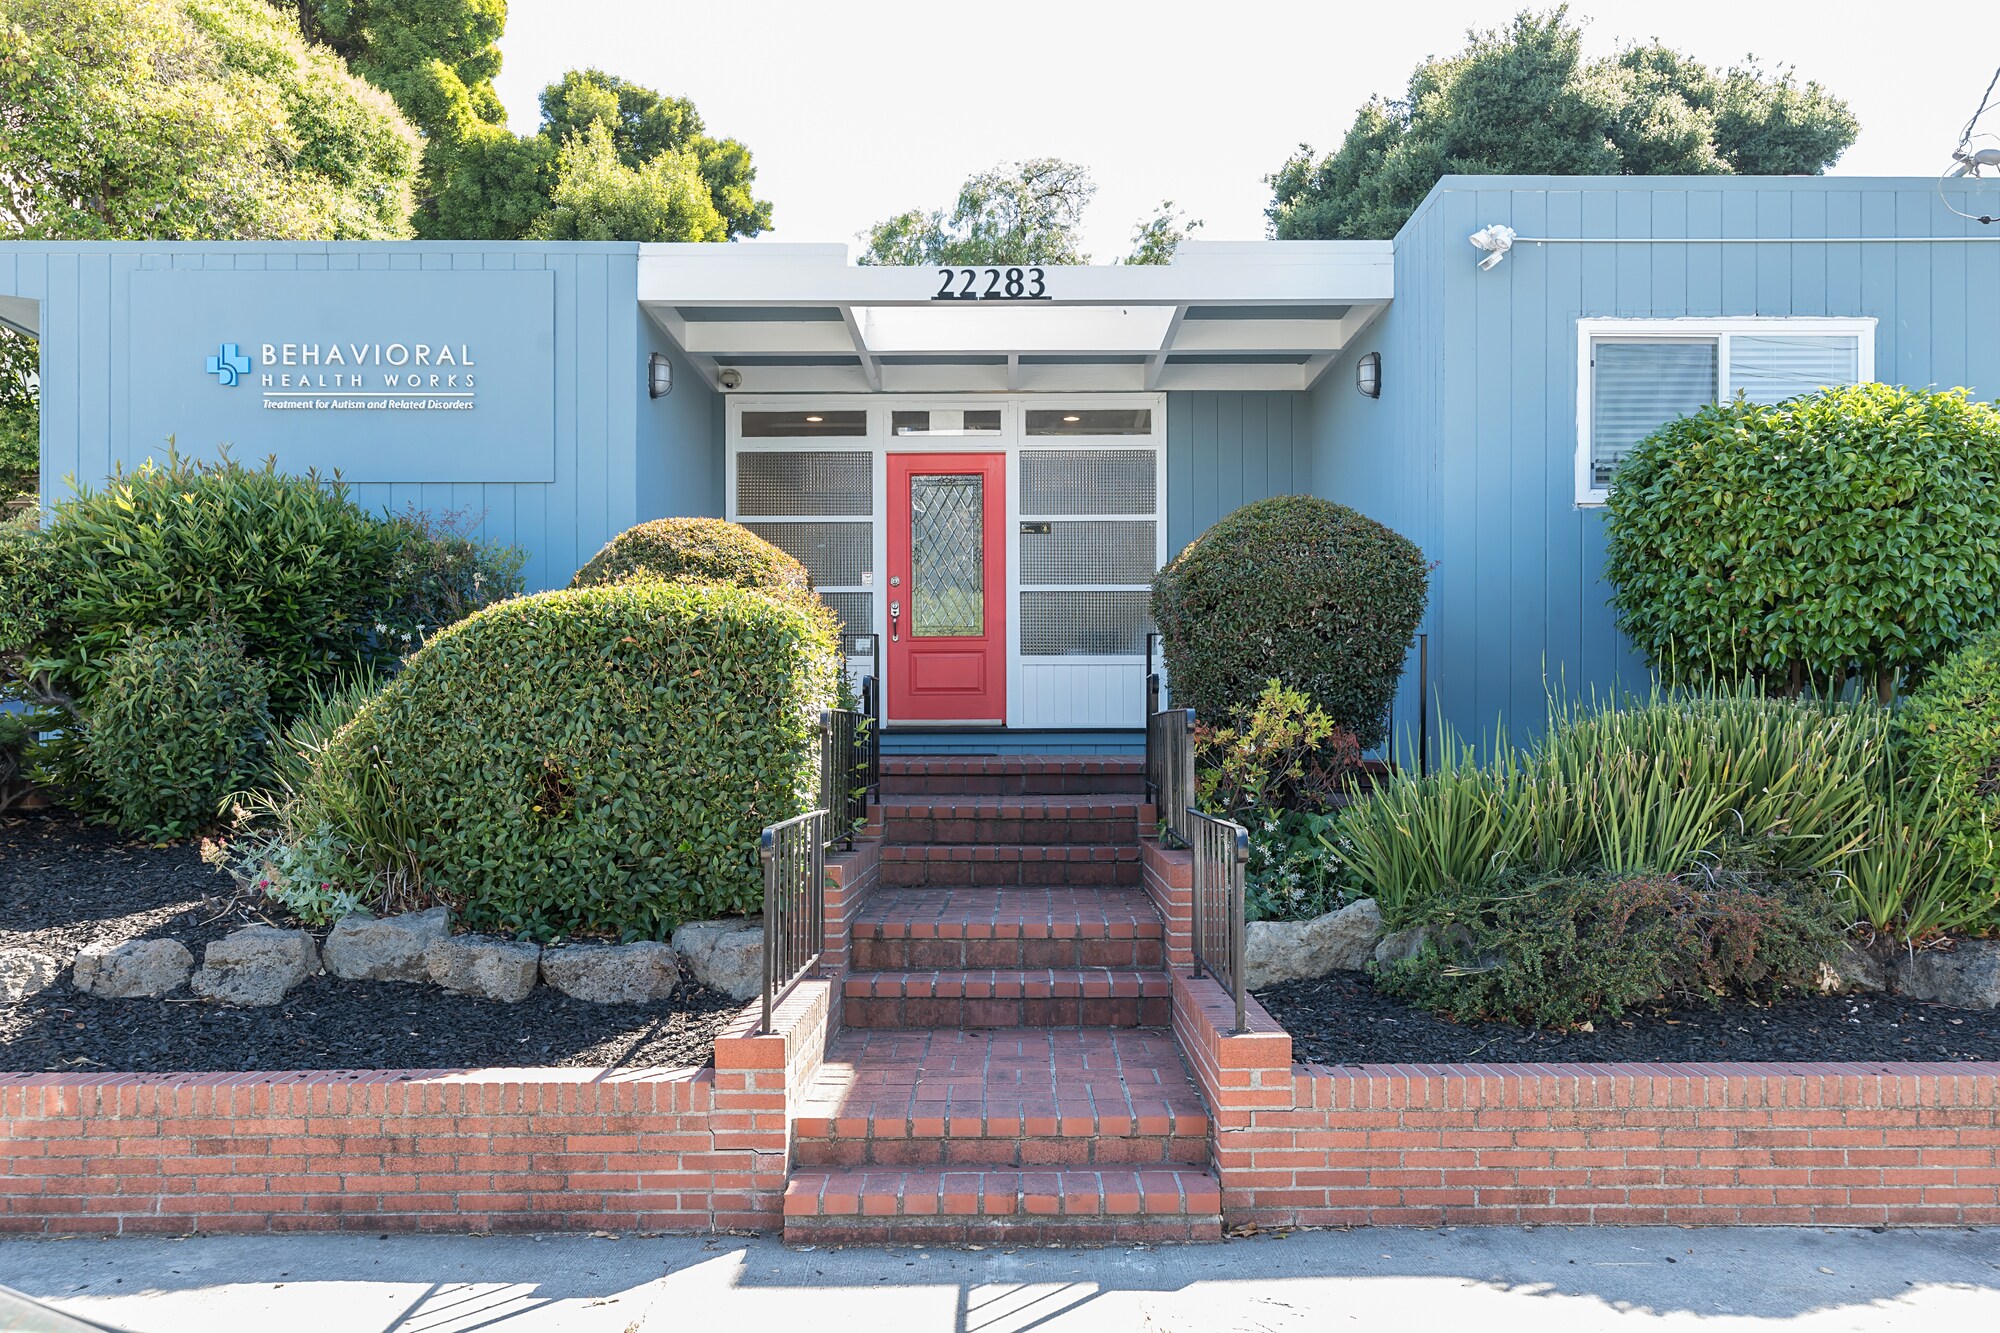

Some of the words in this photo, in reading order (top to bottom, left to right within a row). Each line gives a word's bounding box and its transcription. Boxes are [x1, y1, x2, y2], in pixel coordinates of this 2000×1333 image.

[937, 267, 1046, 299] 22283
[262, 343, 475, 366] BEHAVIORAL
[262, 374, 363, 387] HEALTH
[385, 374, 475, 387] WORKS
[263, 399, 313, 410] Treatment
[315, 399, 329, 410] for
[331, 399, 365, 410] Autism
[367, 399, 386, 410] and
[388, 399, 426, 410] Related
[428, 399, 474, 410] Disorders
